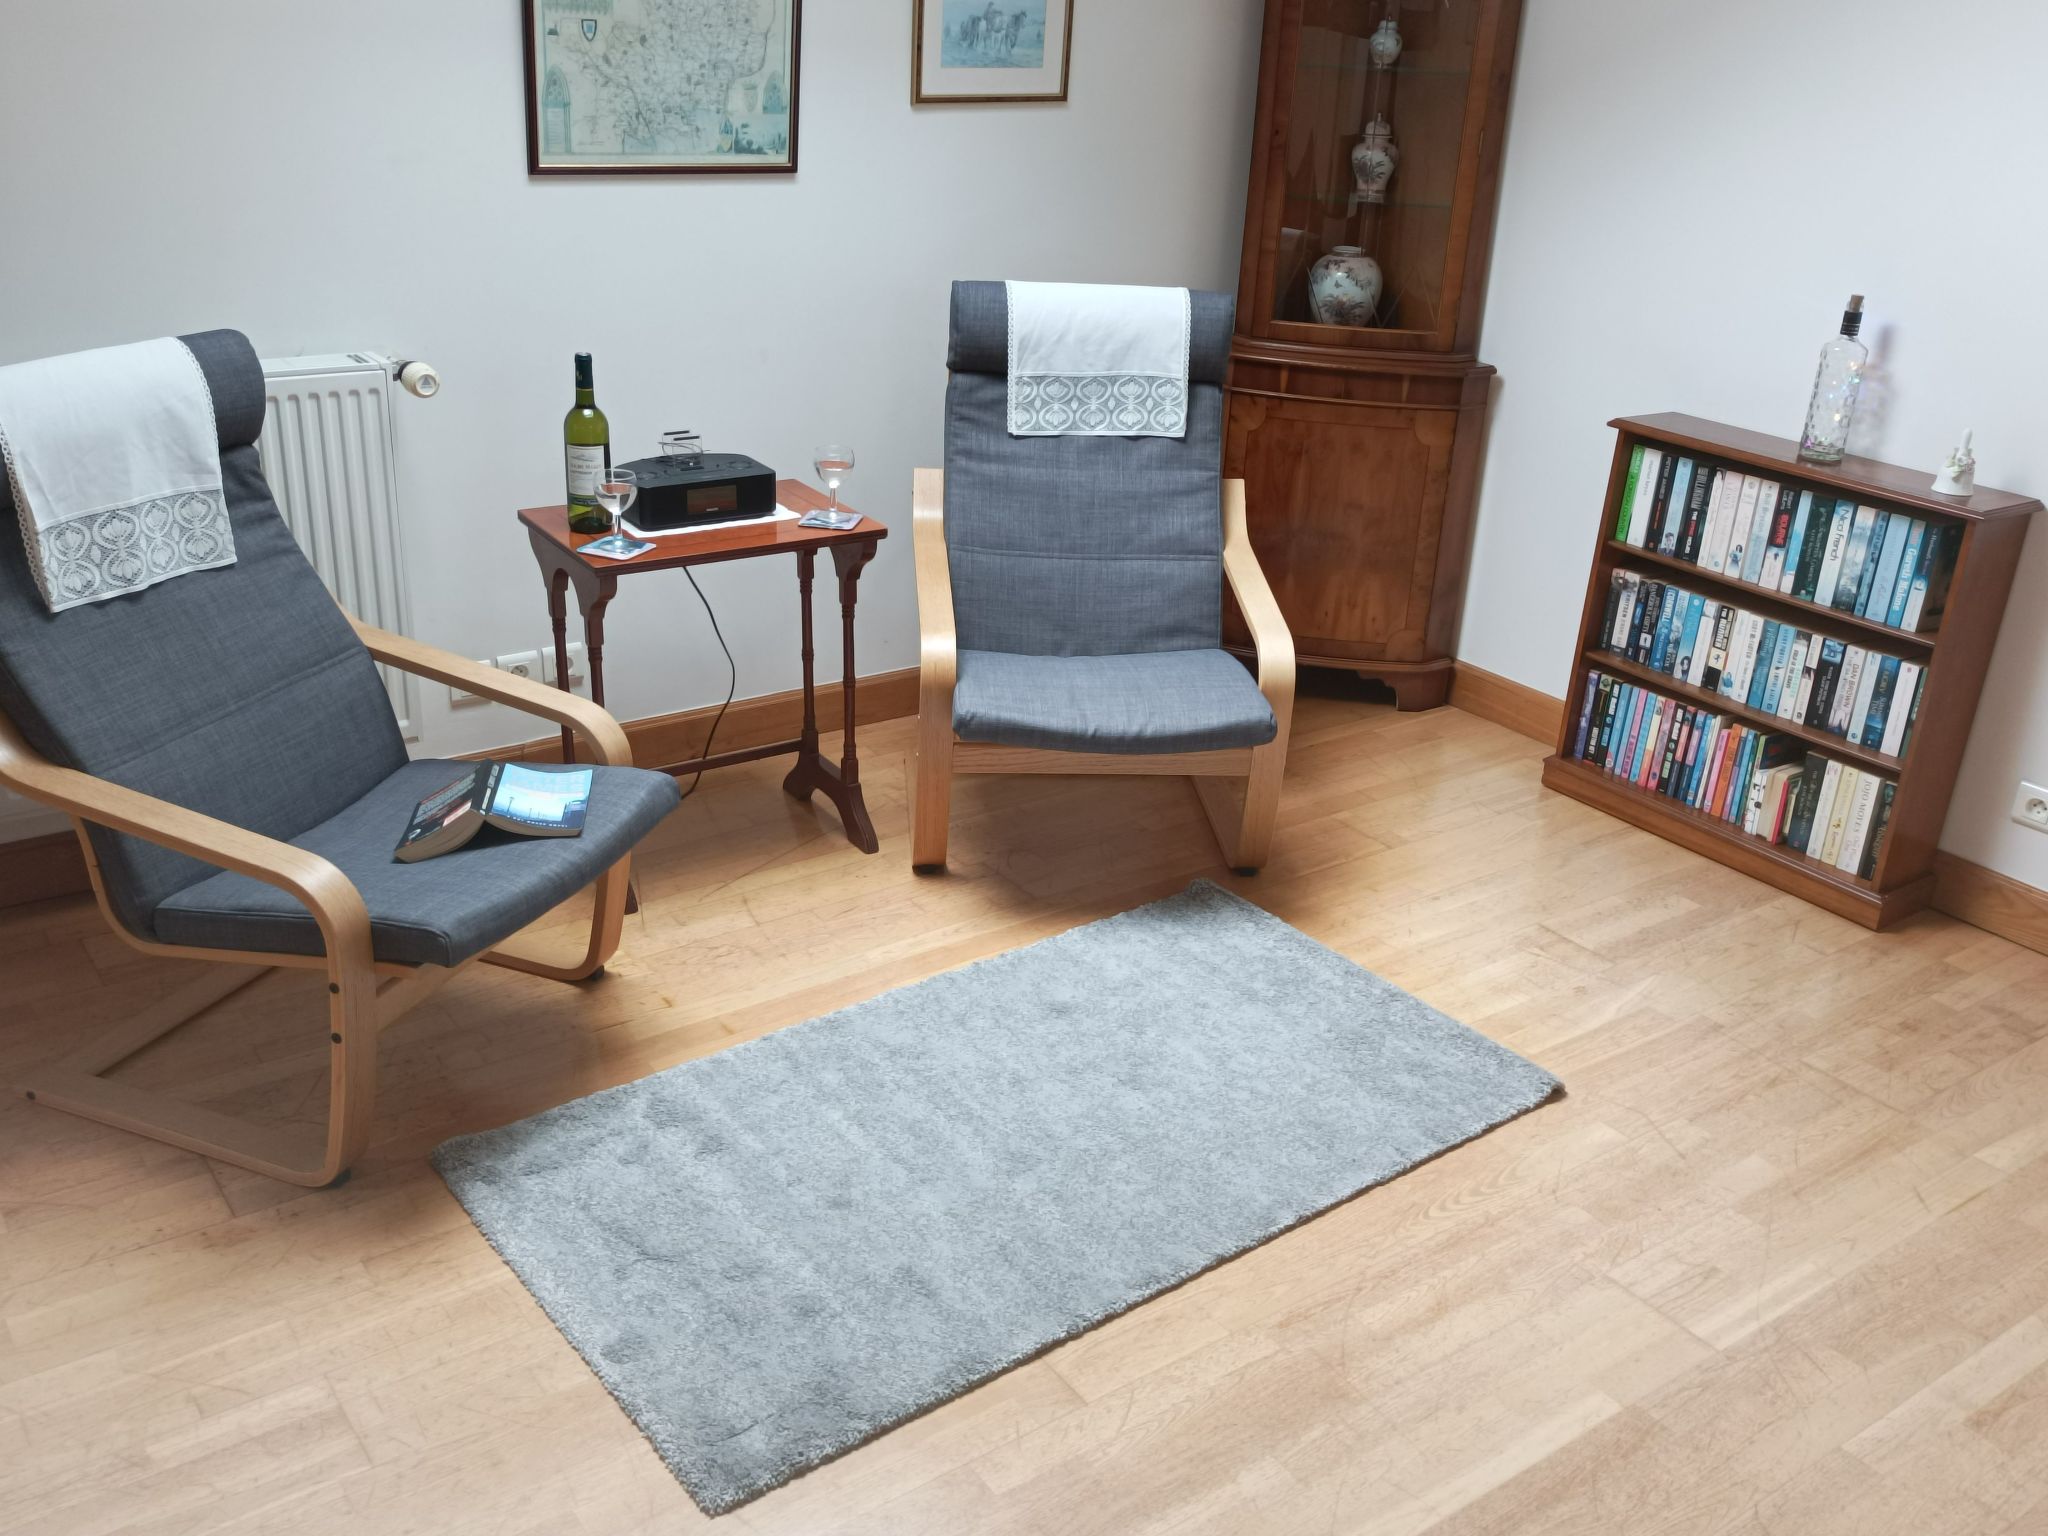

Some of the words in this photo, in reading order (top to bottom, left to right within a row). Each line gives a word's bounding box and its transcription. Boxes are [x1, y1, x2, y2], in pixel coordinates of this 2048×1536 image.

[1835, 508, 1850, 533] Nicci
[1828, 532, 1844, 562] French
[1900, 547, 1917, 579] Gareth
[1661, 591, 1675, 623] CORNWELL
[1891, 579, 1908, 612] Malone
[1848, 662, 1860, 680] DAN
[1841, 678, 1856, 708] BROWN
[1858, 778, 1873, 801] JOJO
[1851, 801, 1867, 833] MOYES
